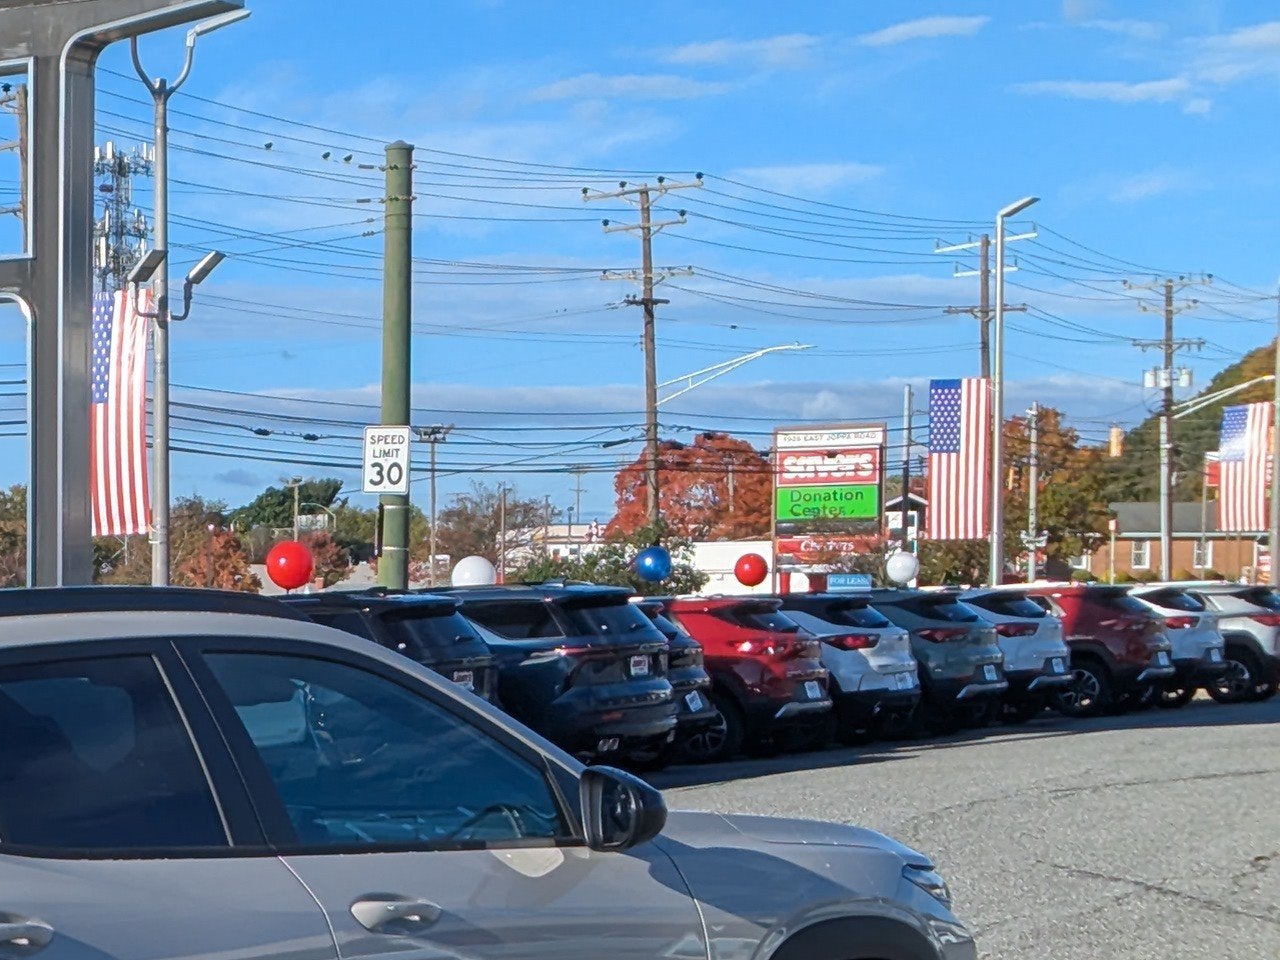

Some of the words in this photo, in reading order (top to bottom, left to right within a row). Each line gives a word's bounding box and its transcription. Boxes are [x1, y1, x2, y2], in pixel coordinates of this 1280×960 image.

[370, 435, 405, 444] SPEED
[372, 448, 401, 458] LIMIT
[369, 462, 403, 486] 30
[791, 488, 864, 502] Donation
[791, 504, 847, 516] Center
[830, 577, 845, 585] FOR
